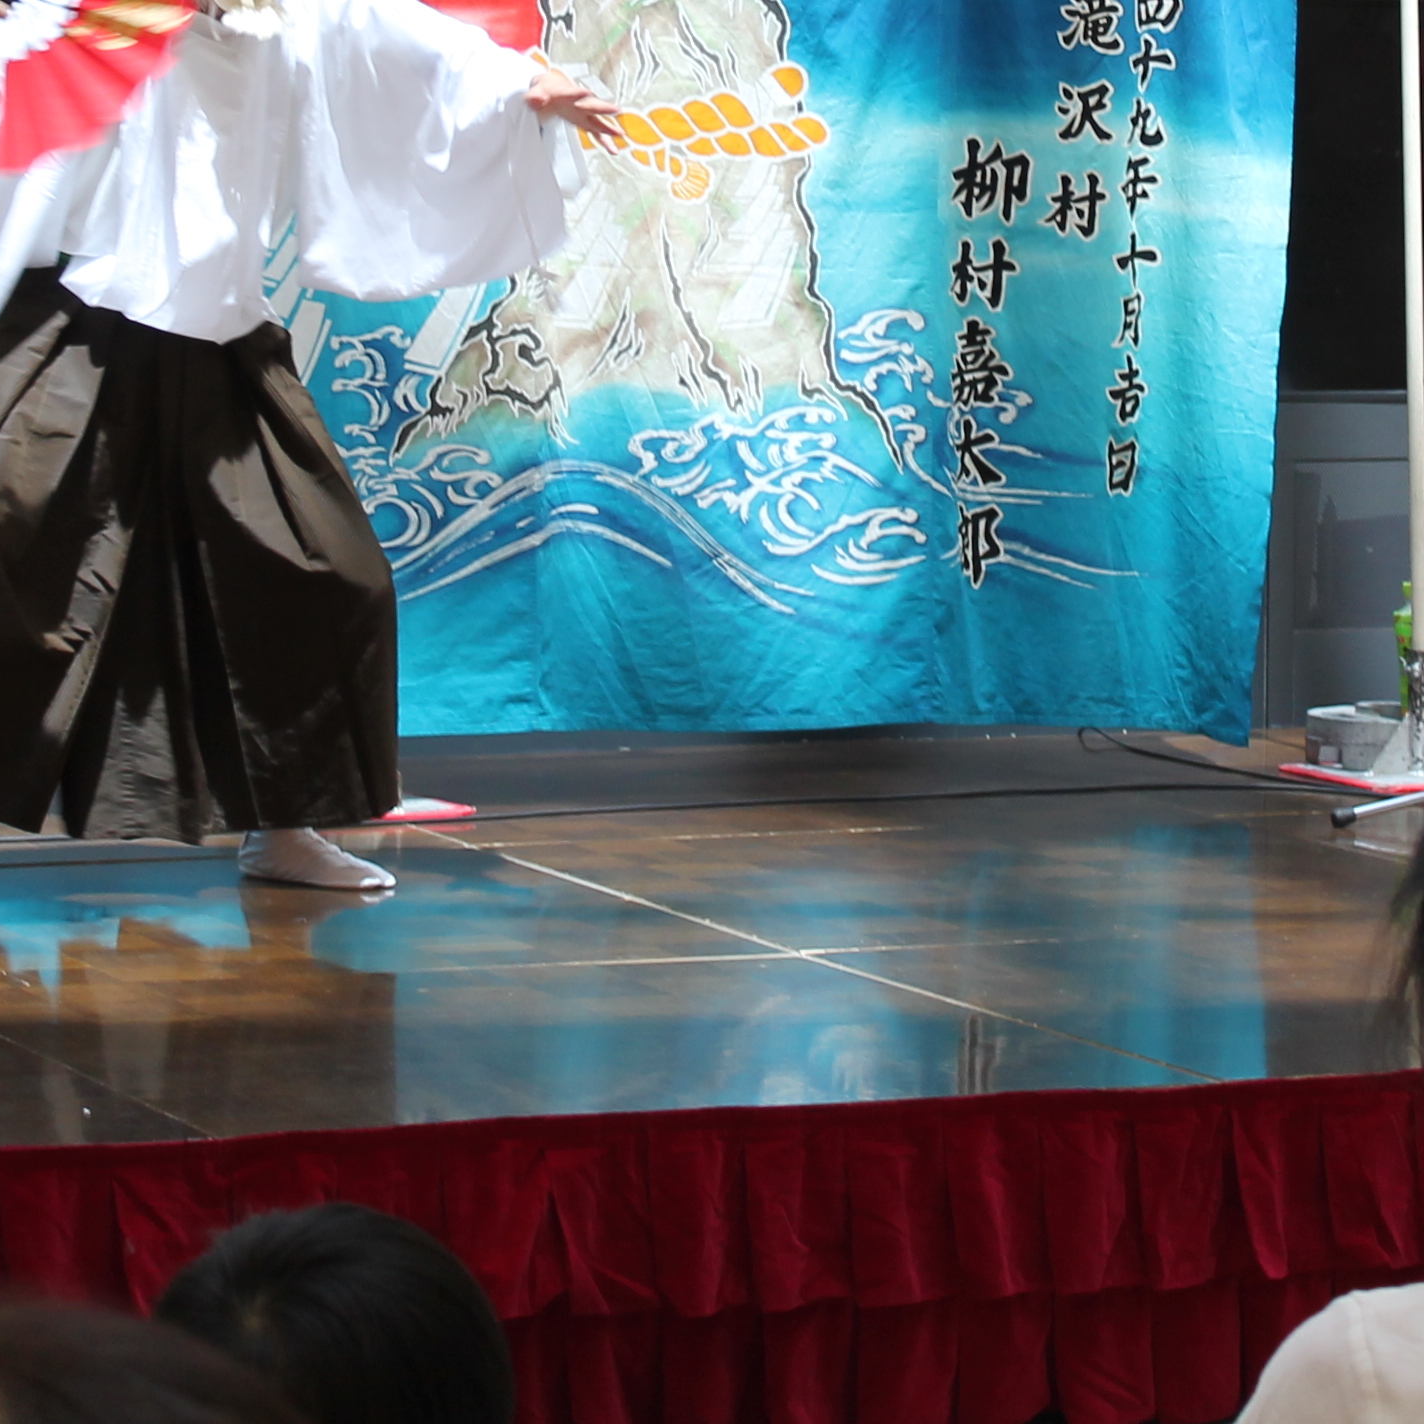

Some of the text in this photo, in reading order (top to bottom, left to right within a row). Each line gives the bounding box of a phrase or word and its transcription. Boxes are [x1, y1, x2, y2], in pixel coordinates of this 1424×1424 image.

[950, 137, 1032, 588] 柳村嘉太郎
